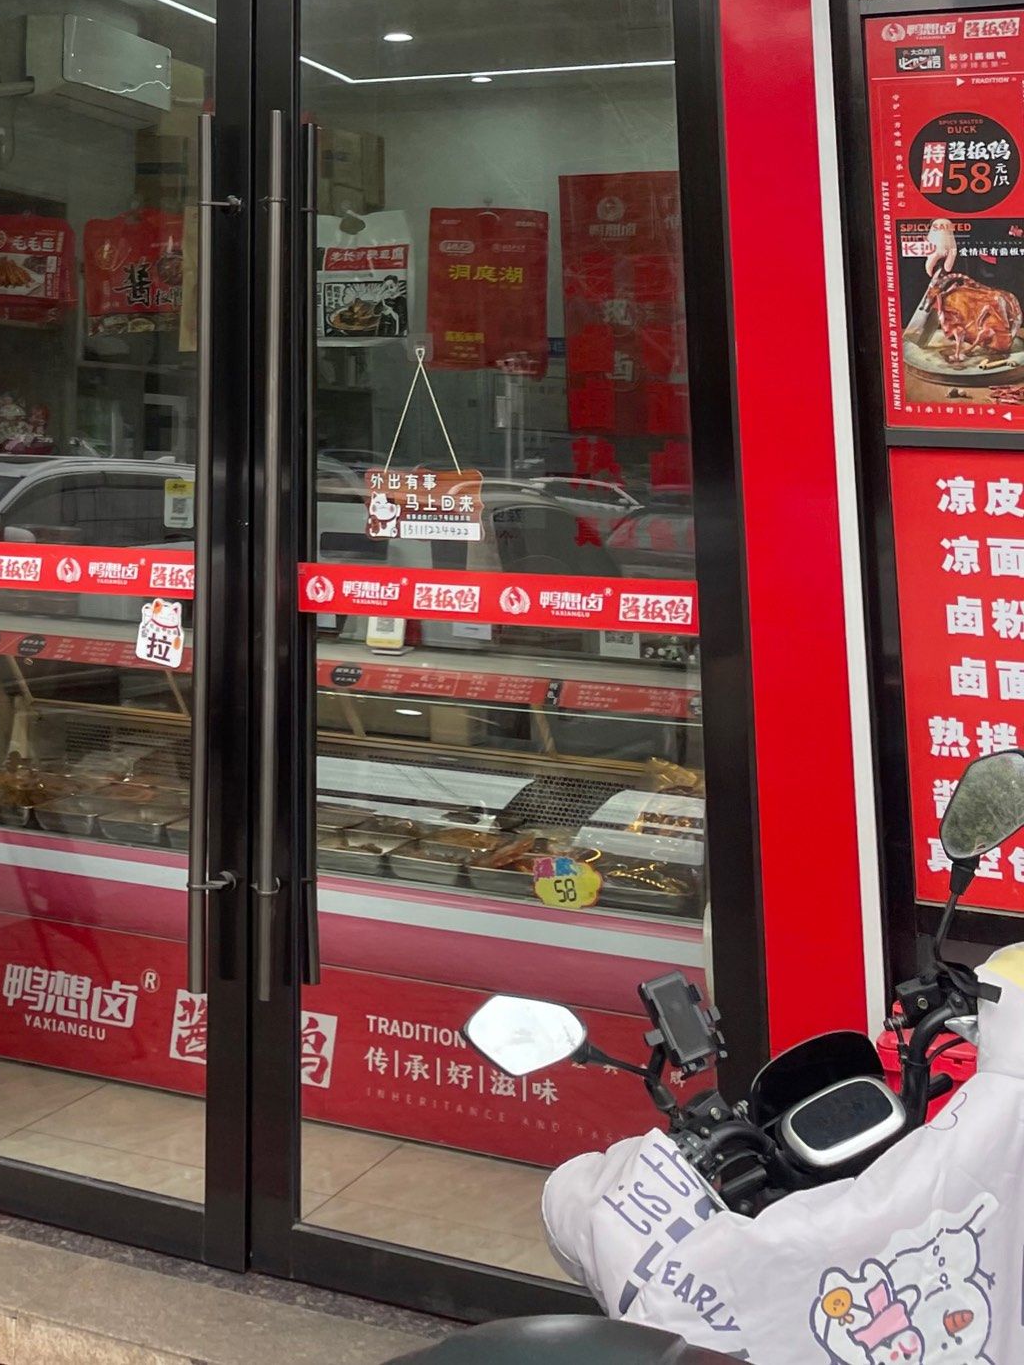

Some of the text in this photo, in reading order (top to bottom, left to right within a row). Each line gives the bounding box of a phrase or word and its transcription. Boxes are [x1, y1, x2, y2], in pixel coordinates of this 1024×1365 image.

[947, 125, 977, 135] DUCK
[920, 143, 946, 188] 特价
[947, 139, 1012, 162] 酱板鸭
[945, 162, 992, 195] 58
[882, 213, 892, 232] AND
[448, 264, 524, 284] 洞庭湖
[883, 234, 895, 292] INHERITANCE
[888, 329, 899, 349] AND
[890, 351, 902, 411] INHERITANCE
[370, 473, 437, 491] 外出有事
[936, 476, 1024, 518] 凉皮
[405, 493, 475, 512] 马上回来
[88, 561, 139, 580] 鸭想卤
[940, 535, 1024, 578] 凉面
[341, 579, 692, 625] 鸭想卤 酱板鸭 鸭想卤 酱板鸭
[146, 632, 171, 662] 拉
[553, 878, 577, 903] 58
[2, 963, 139, 1029] 鸭想卤
[23, 1013, 107, 1041] YAXIANGLU
[365, 1014, 468, 1050] TRADITION
[366, 1087, 506, 1124] INHERITANCE
